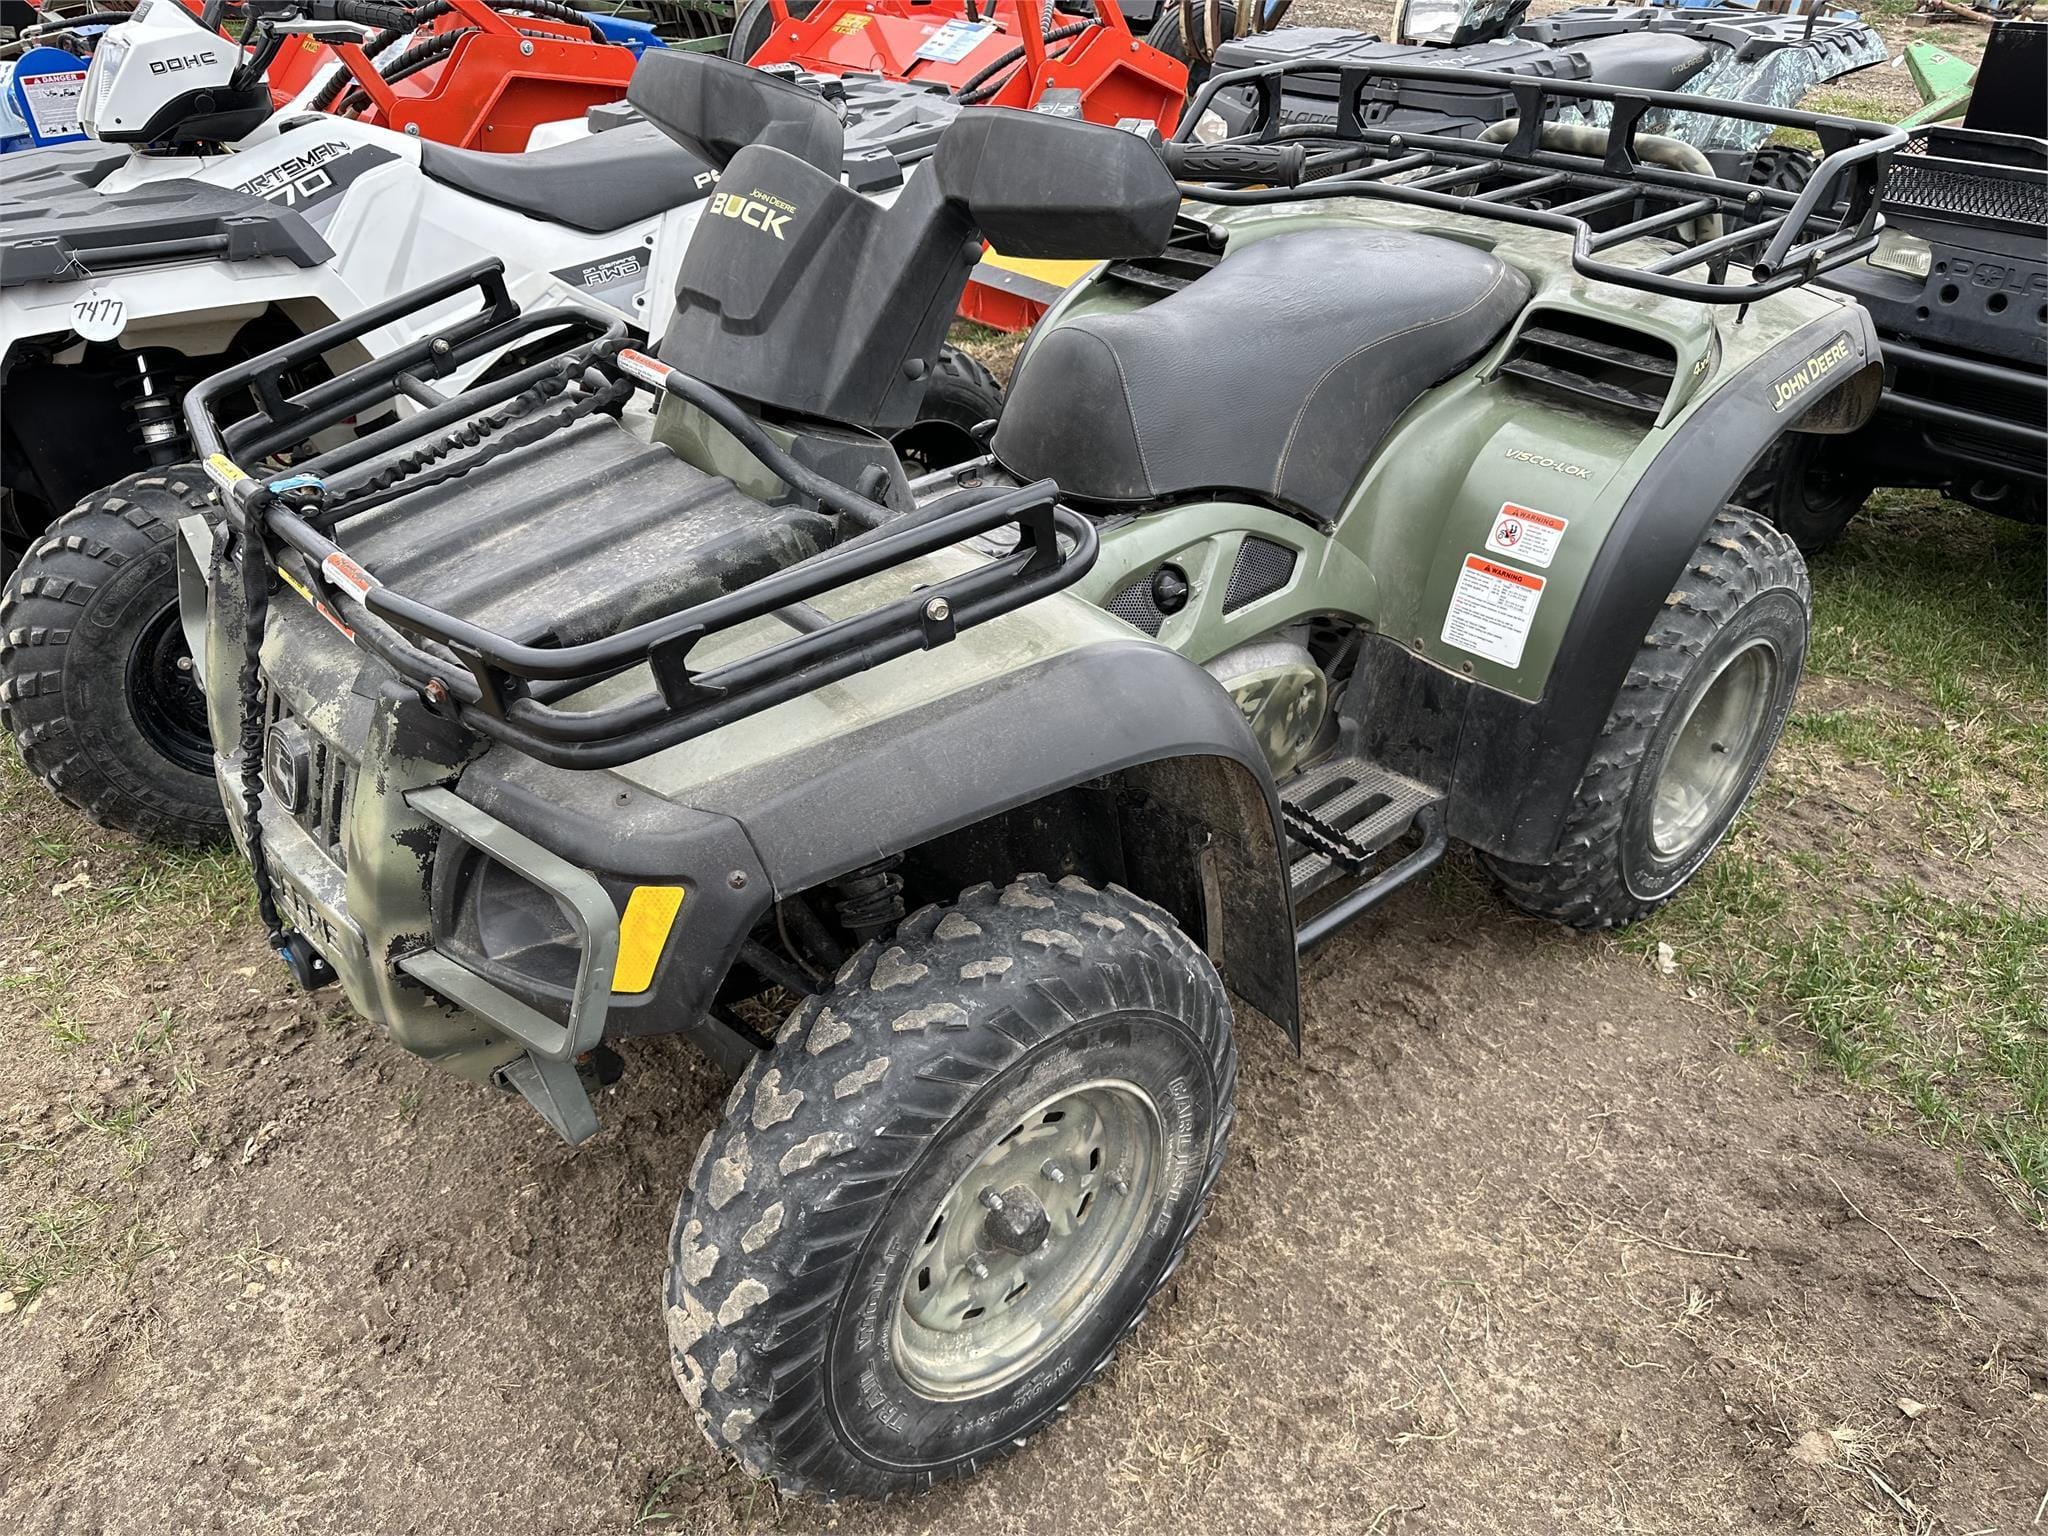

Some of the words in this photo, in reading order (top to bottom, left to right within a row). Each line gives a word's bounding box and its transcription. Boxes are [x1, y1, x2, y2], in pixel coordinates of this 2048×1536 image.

[149, 51, 218, 75] DOHC
[1671, 54, 1705, 75] POLARIS
[42, 73, 78, 84] DANGER
[749, 188, 770, 202] JOHN
[769, 196, 797, 214] DEERE
[709, 192, 793, 241] BUCK
[583, 260, 641, 288] AWD
[73, 298, 124, 326] 7477
[1773, 369, 1810, 407] JOHN
[1806, 339, 1849, 381] DEERE
[1504, 448, 1592, 480] VISCO-LOK
[1519, 511, 1554, 527] WARNING
[1491, 567, 1523, 583] WARNING
[1153, 1075, 1193, 1237] CARLISLE
[855, 1233, 901, 1353] WOLF
[857, 1357, 908, 1434] TRAIL
